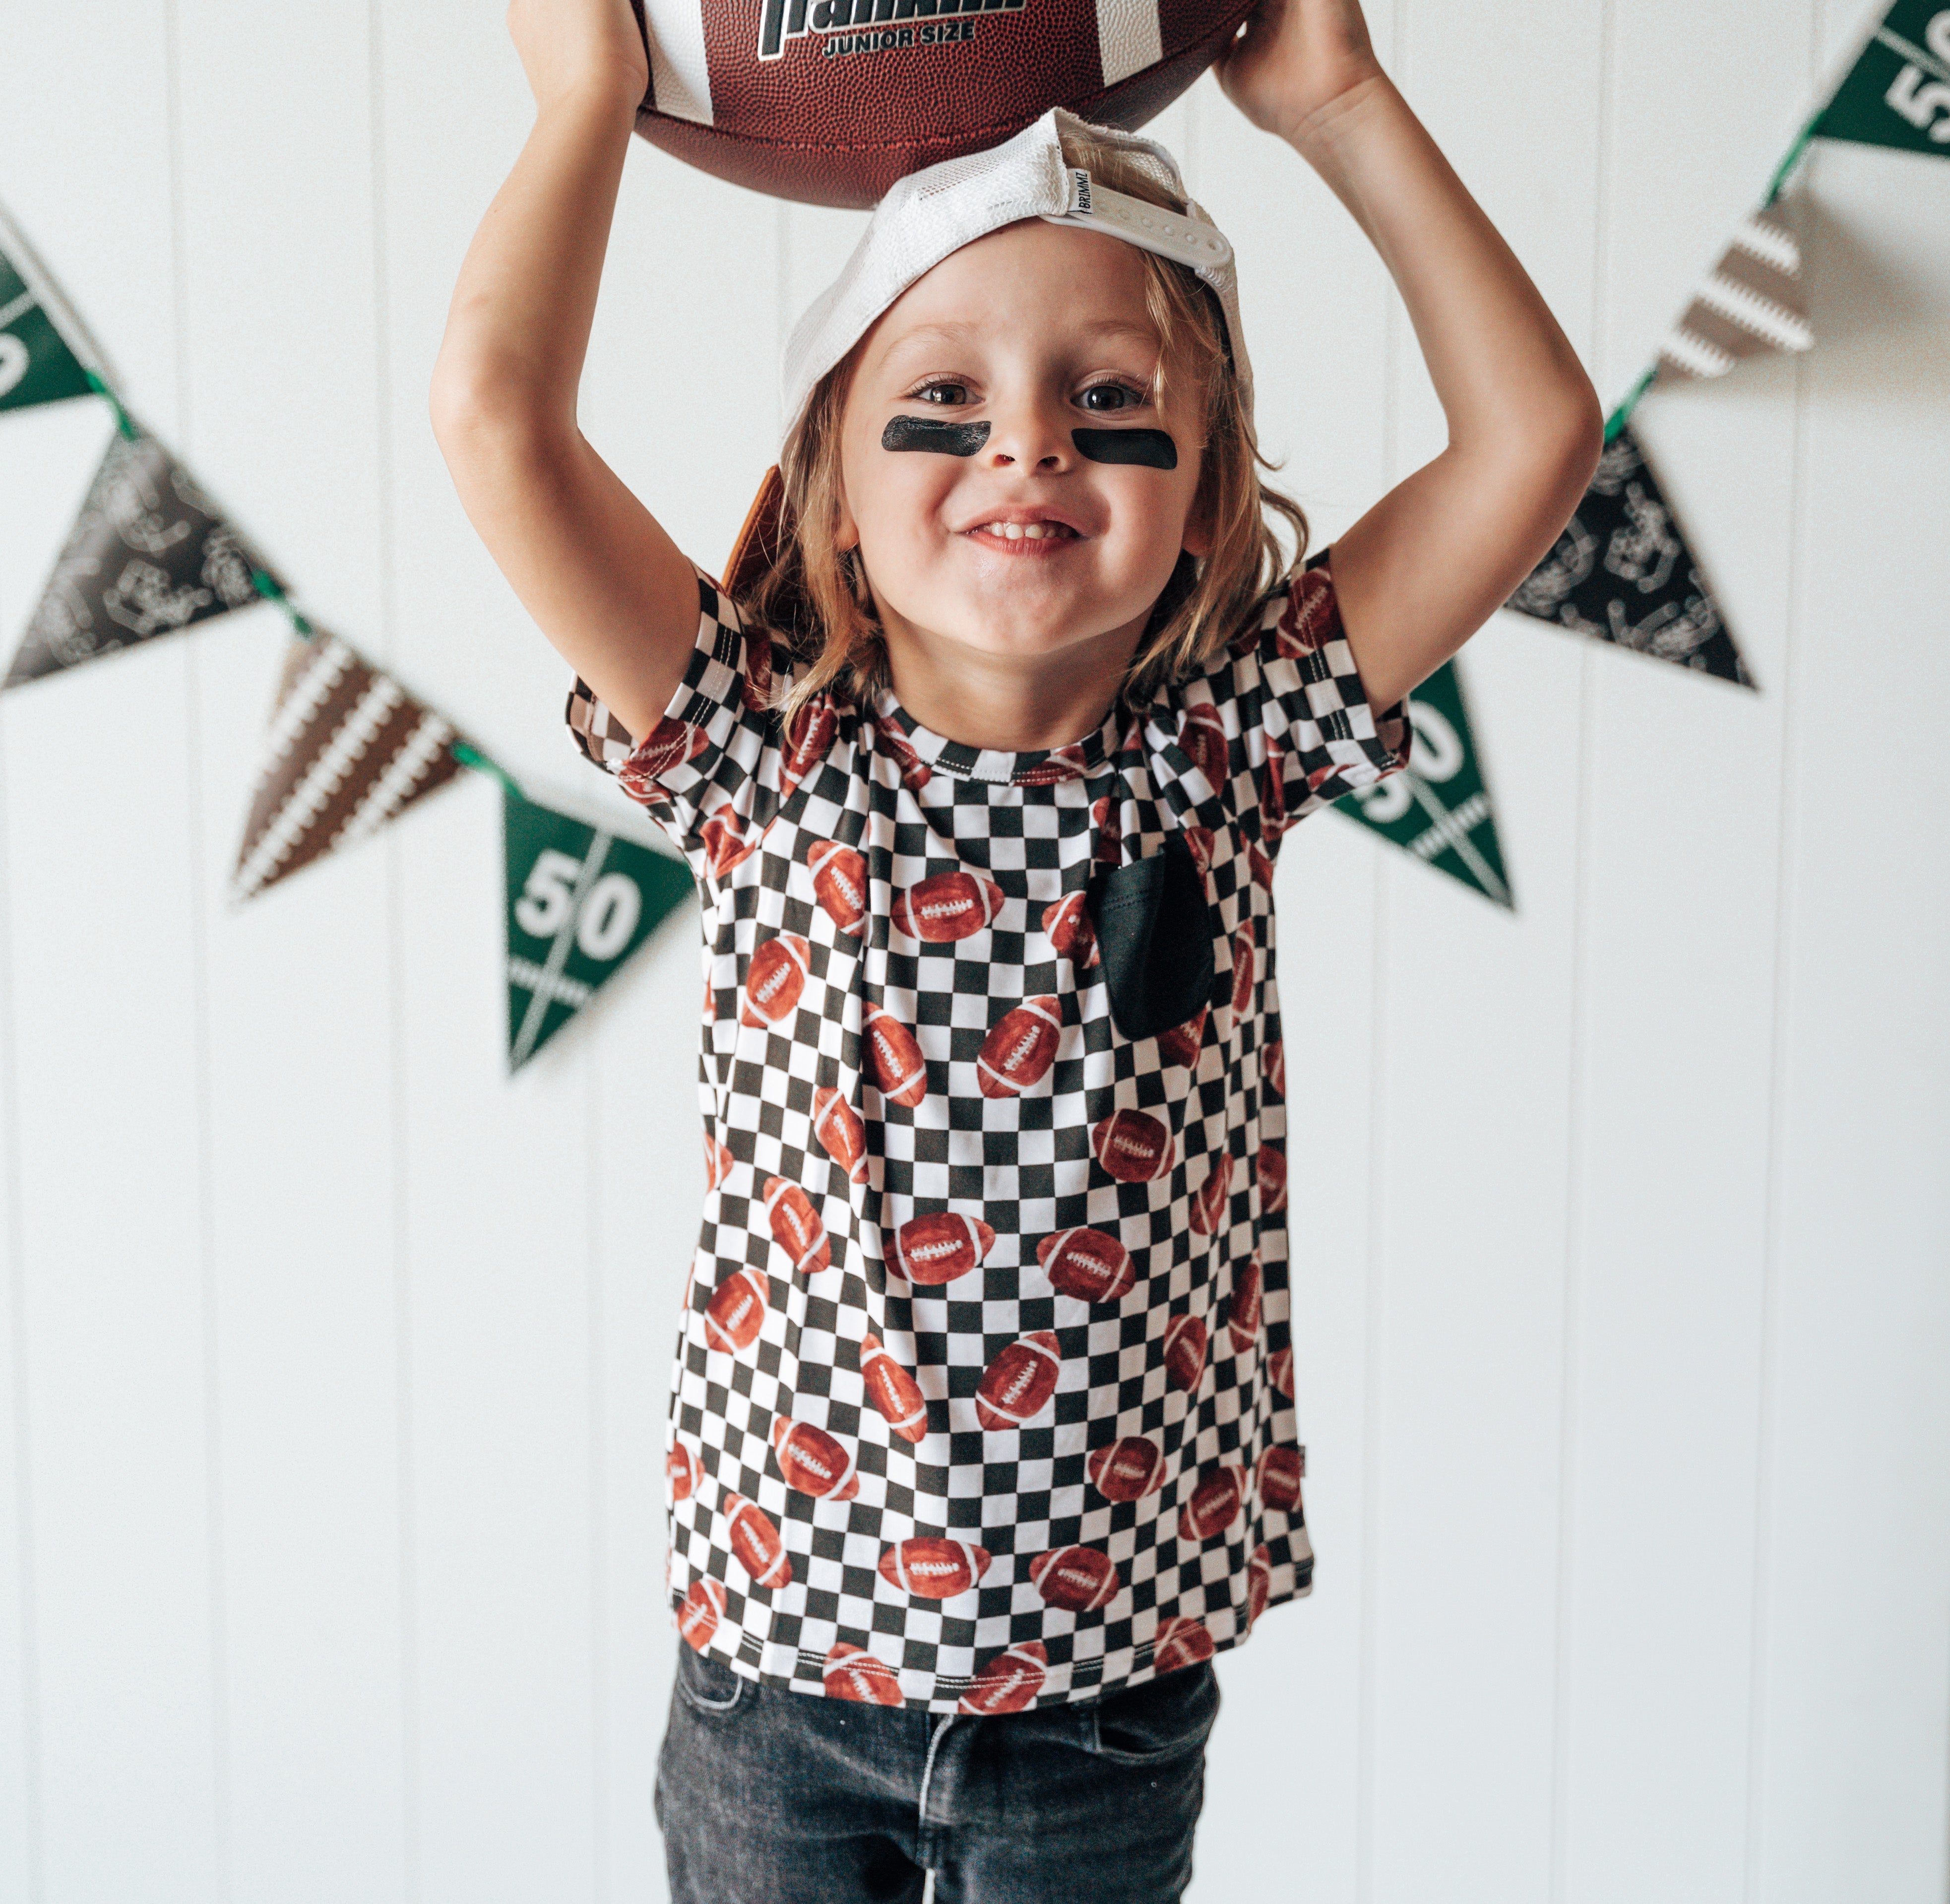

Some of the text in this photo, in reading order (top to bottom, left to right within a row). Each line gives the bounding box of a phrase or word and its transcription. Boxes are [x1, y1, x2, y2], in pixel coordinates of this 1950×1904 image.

[821, 28, 915, 59] JUNIOR
[920, 20, 976, 46] SIZE
[1075, 172, 1091, 209] BRIMMZ
[514, 847, 642, 961] 50
